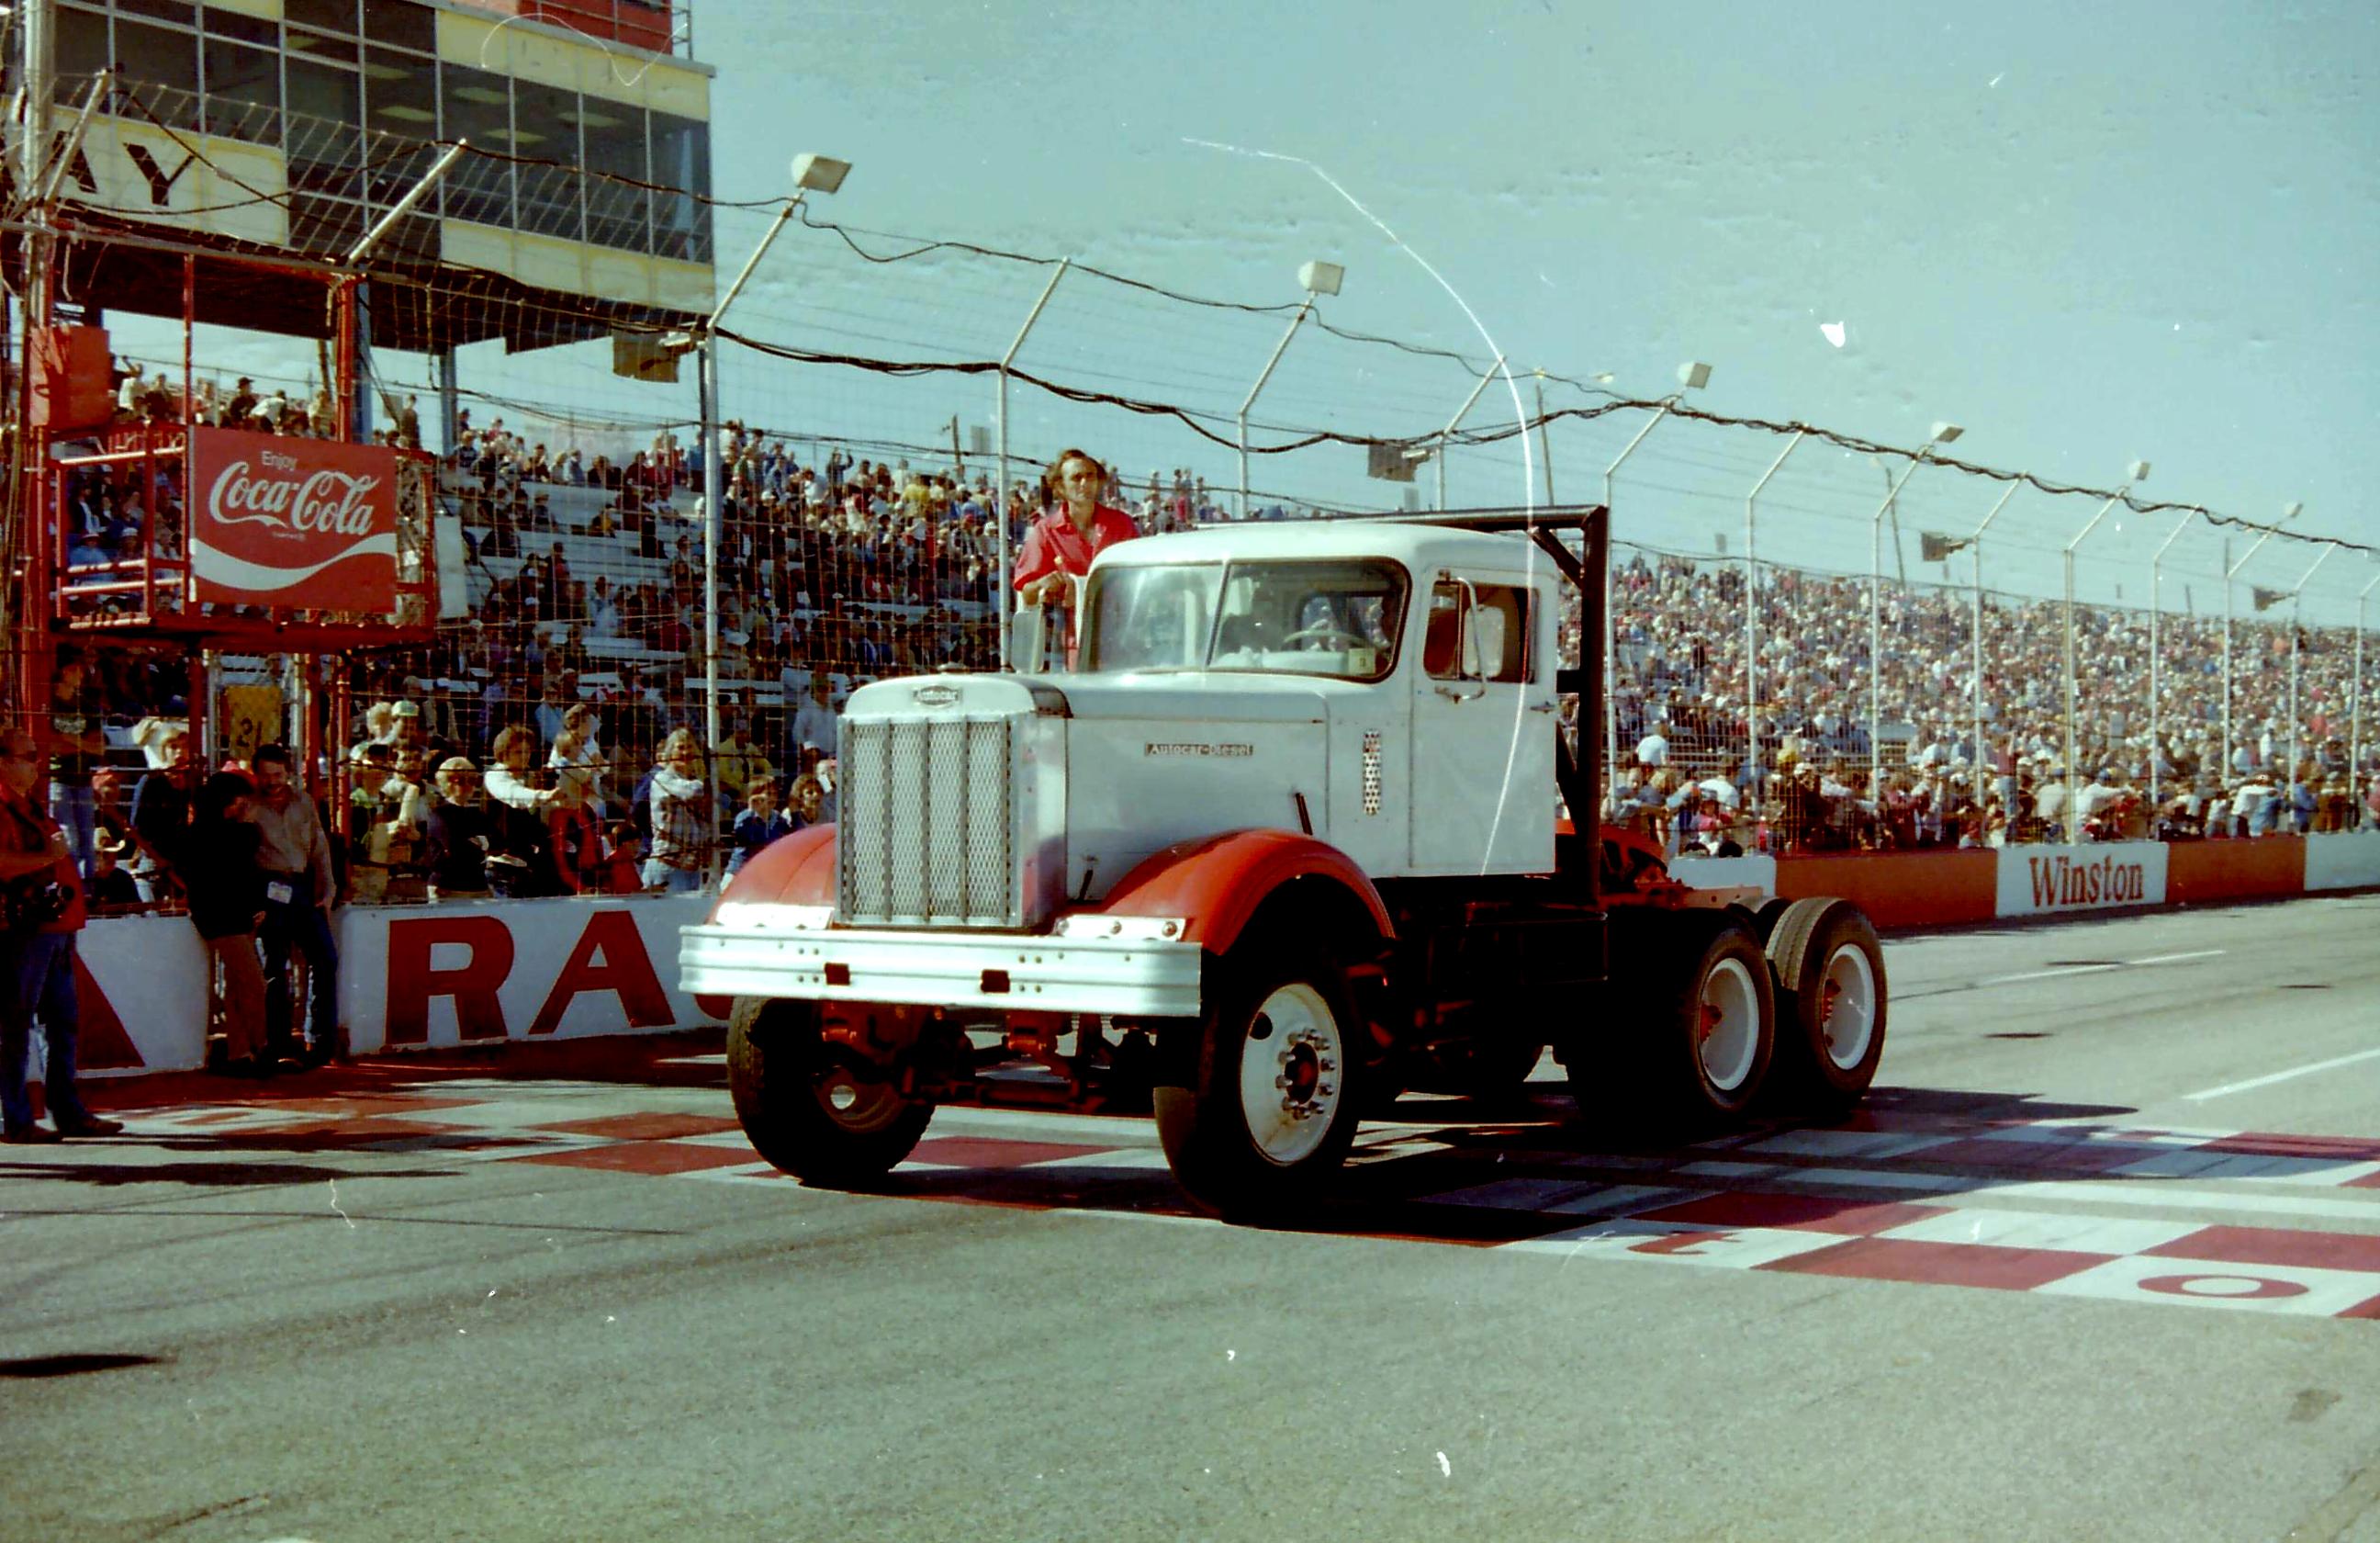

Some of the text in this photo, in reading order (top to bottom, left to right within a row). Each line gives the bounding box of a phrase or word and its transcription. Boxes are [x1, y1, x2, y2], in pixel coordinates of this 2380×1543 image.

[0, 130, 196, 206] AY
[209, 461, 382, 535] Coca-Cola
[262, 450, 298, 472] Enjoy
[2029, 855, 2143, 907] Winston
[385, 910, 733, 1045] RA
